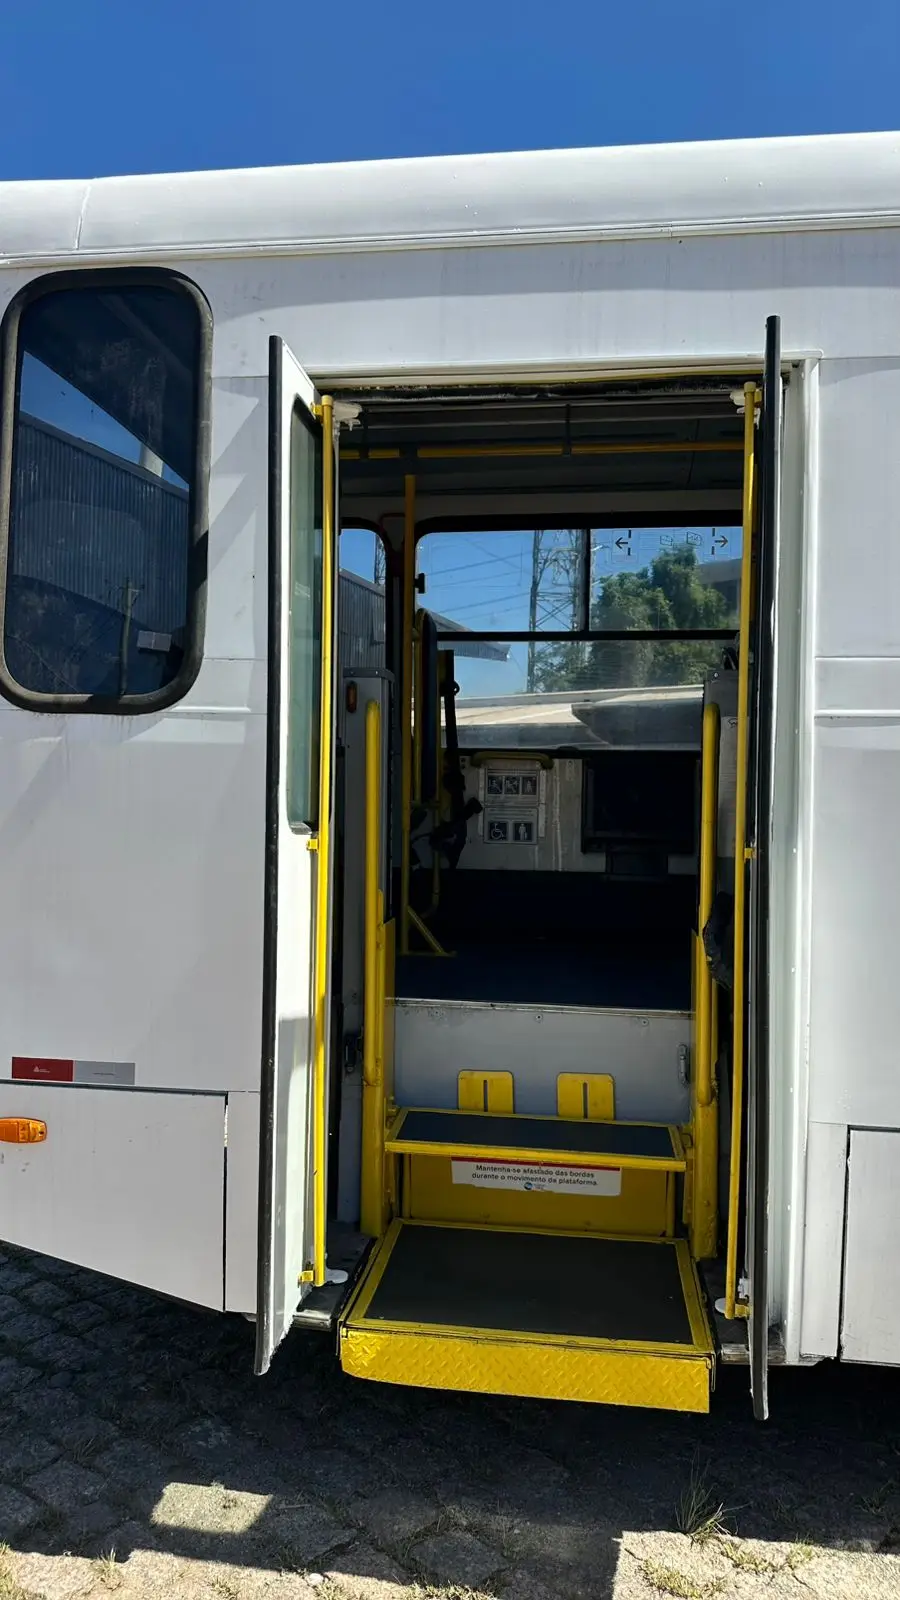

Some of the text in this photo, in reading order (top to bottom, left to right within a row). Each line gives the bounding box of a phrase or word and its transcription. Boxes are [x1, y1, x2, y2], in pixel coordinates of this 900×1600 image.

[476, 1164, 521, 1174] Mantenha-se
[523, 1167, 553, 1175] afastado
[555, 1169, 568, 1177] das
[507, 1175, 546, 1183] movimento
